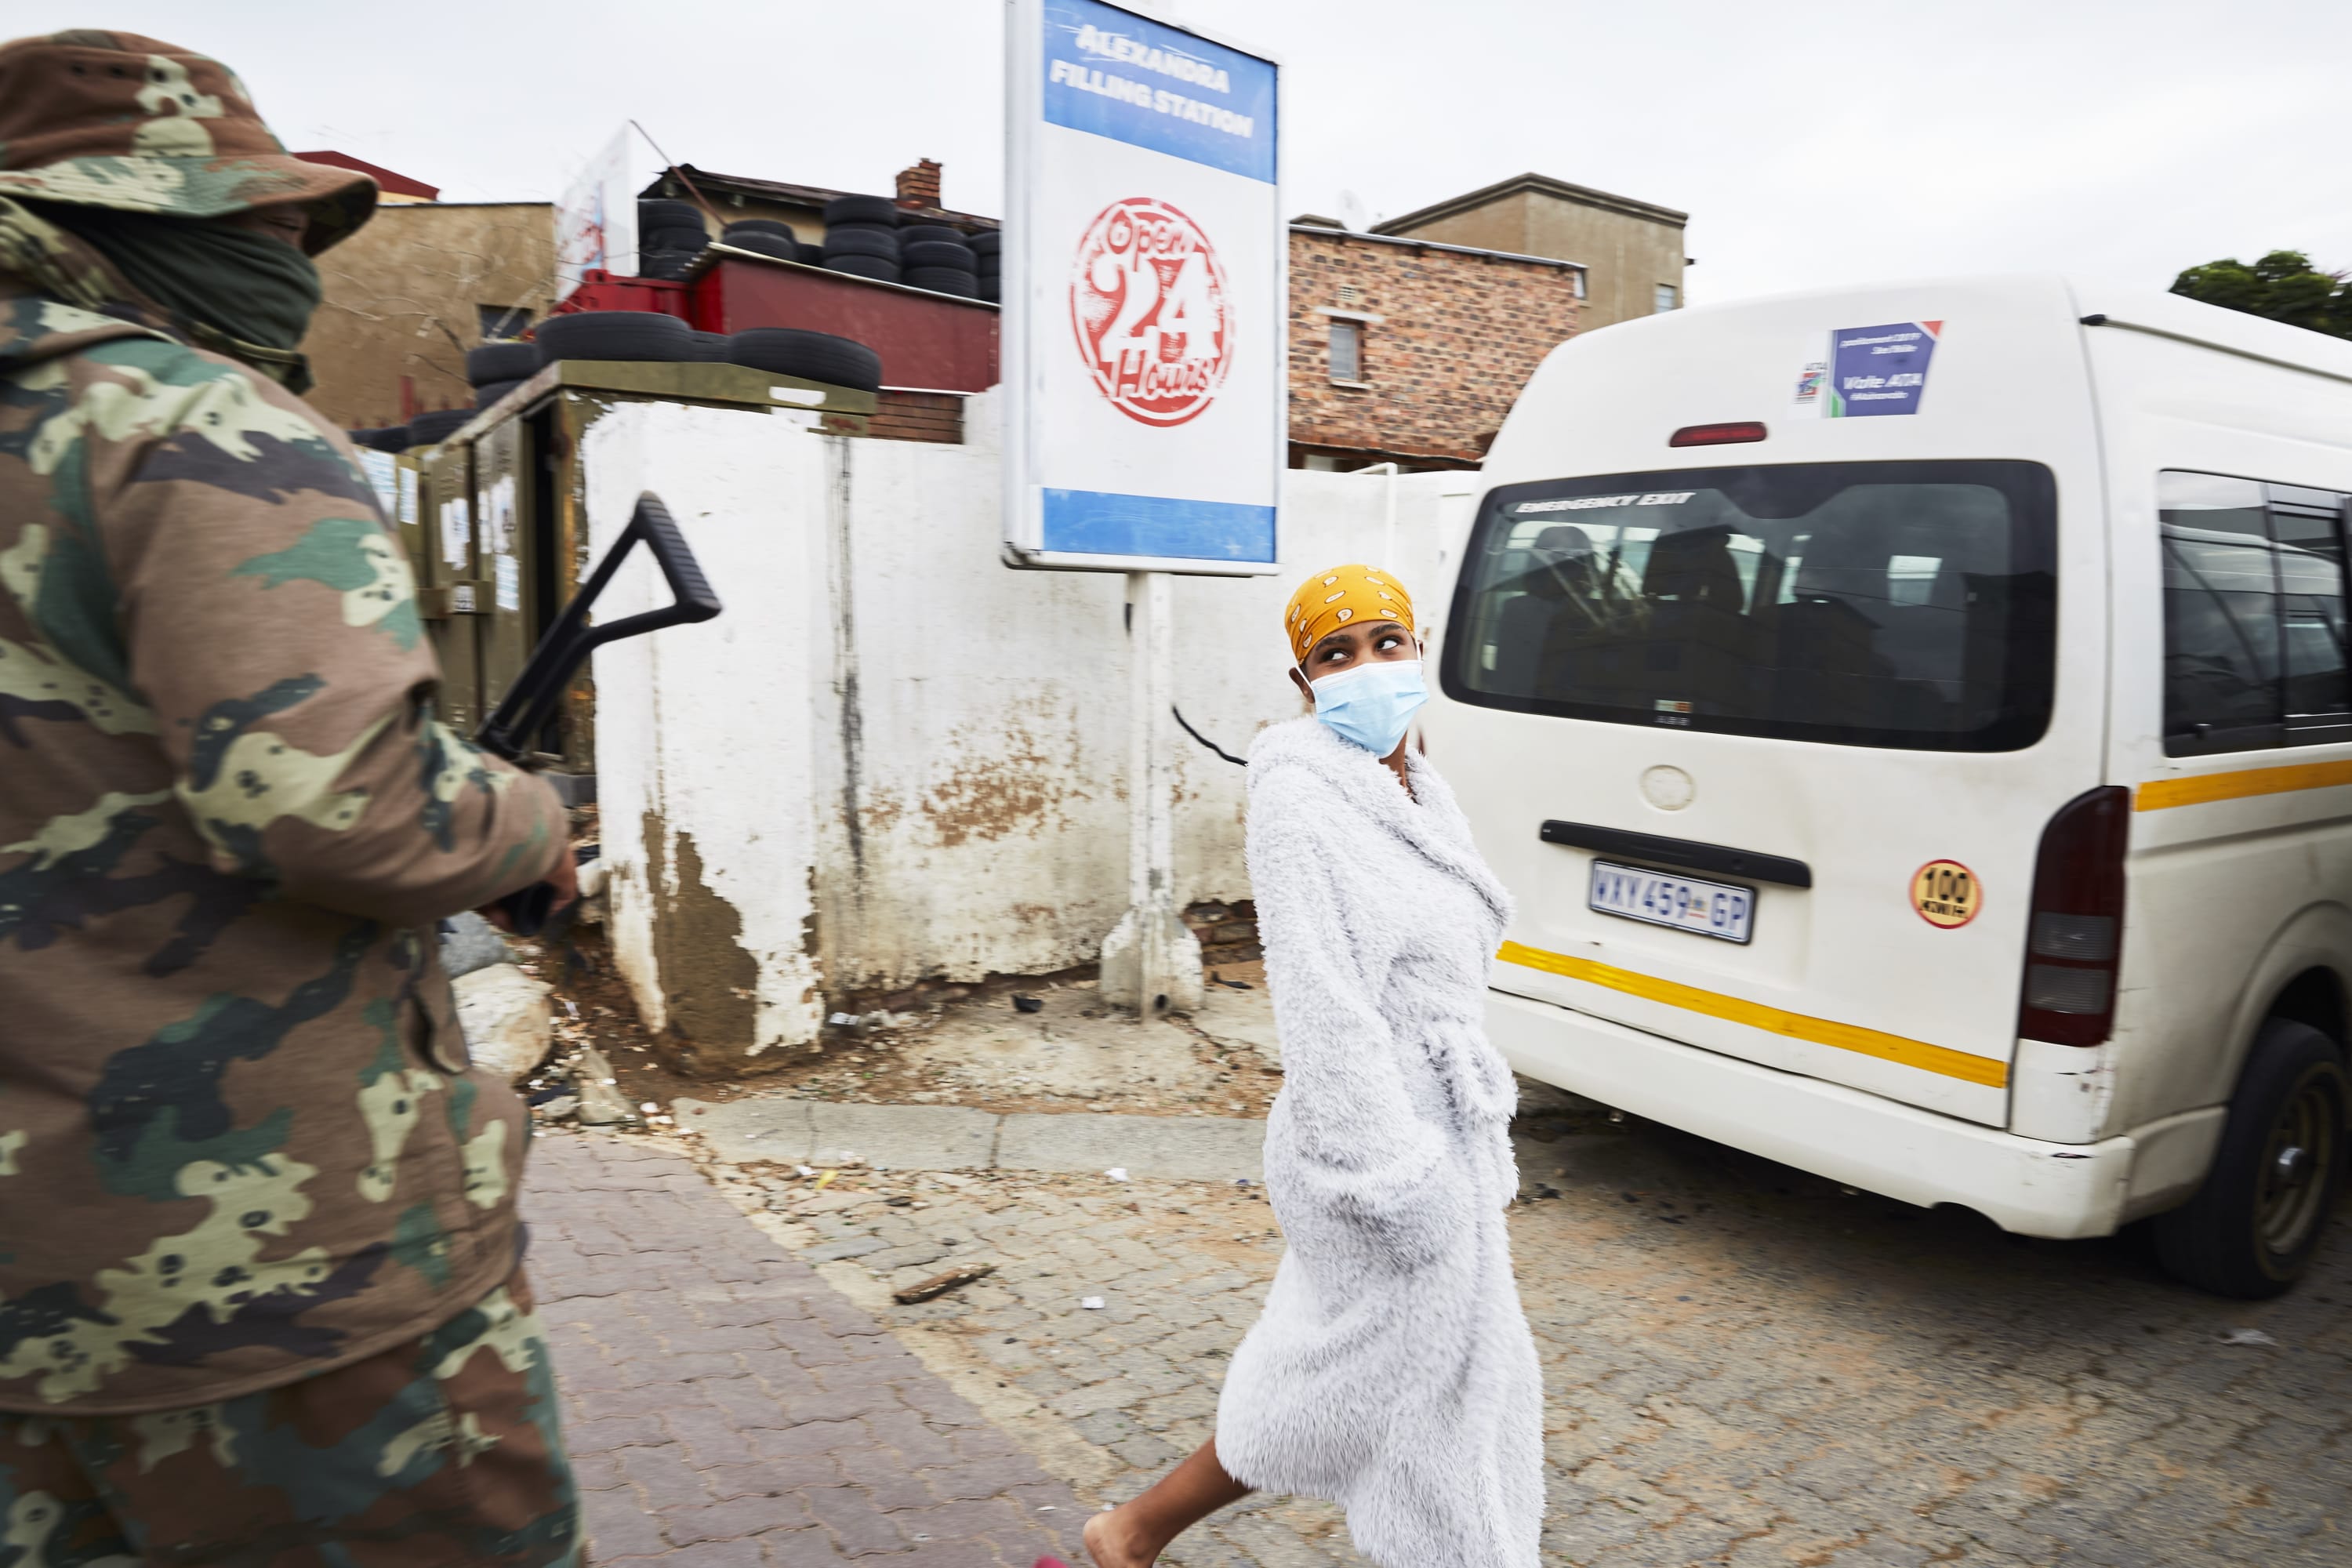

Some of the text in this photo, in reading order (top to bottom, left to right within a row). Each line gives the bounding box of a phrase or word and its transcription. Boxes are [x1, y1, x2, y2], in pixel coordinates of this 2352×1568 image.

[1076, 24, 1230, 93] ALEXANDRA
[1049, 59, 1254, 138] FILLING STATION
[1104, 205, 1196, 270] Open
[1091, 250, 1221, 362] 24
[1110, 348, 1218, 401] Hours
[1843, 375, 1886, 390] Vote
[1515, 492, 1697, 514] EMERGENCY EXIT
[1710, 891, 1748, 931] GP
[1925, 867, 1970, 904] 100
